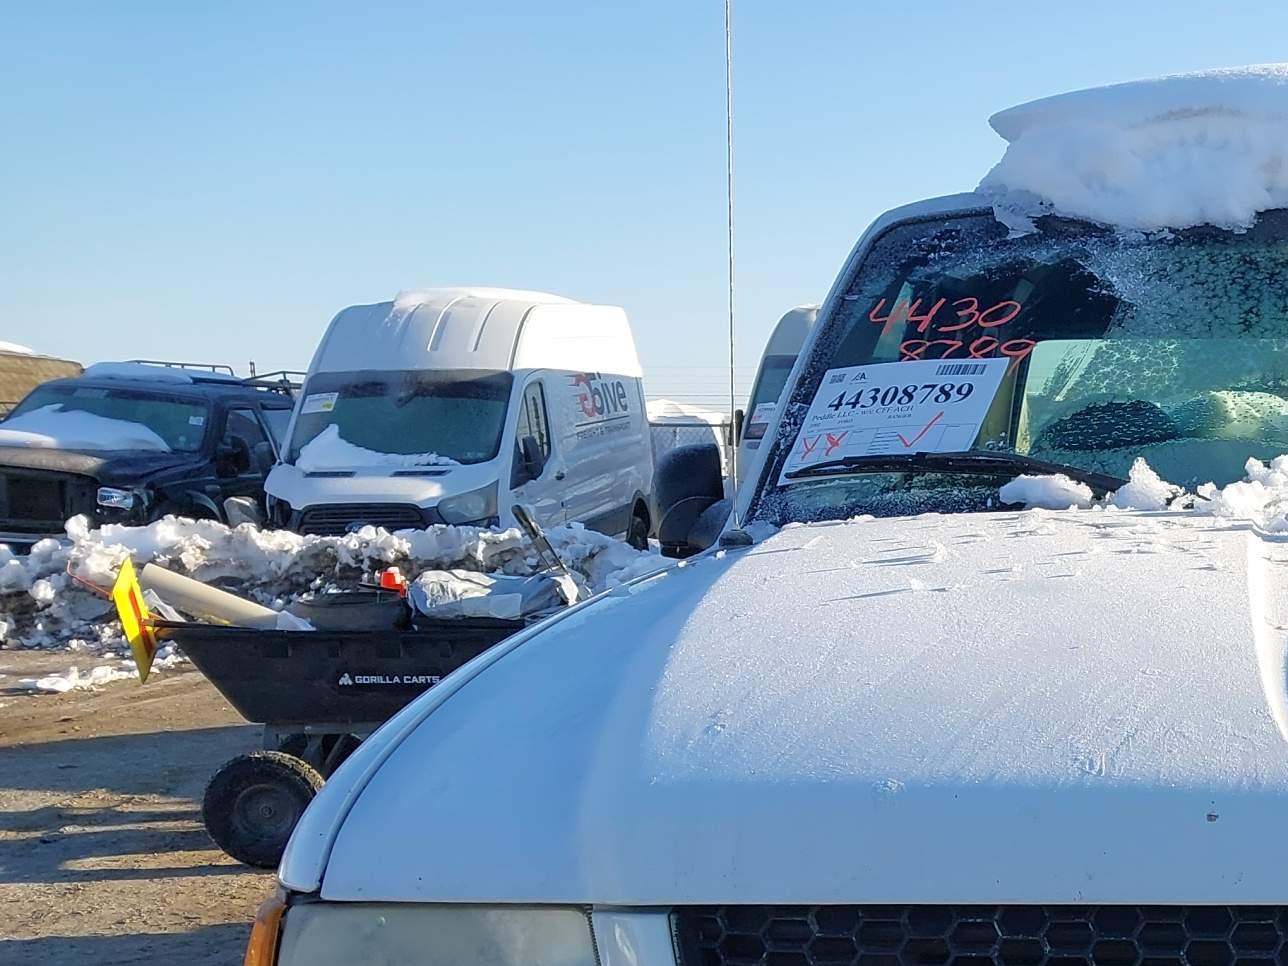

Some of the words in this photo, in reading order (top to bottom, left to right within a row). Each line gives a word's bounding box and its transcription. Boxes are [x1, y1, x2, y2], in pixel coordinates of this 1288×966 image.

[869, 297, 1021, 336] 4430
[901, 336, 1037, 376] 8789
[827, 383, 974, 411] 44308789
[354, 675, 400, 684] GORILLA
[403, 675, 440, 684] CARTS
